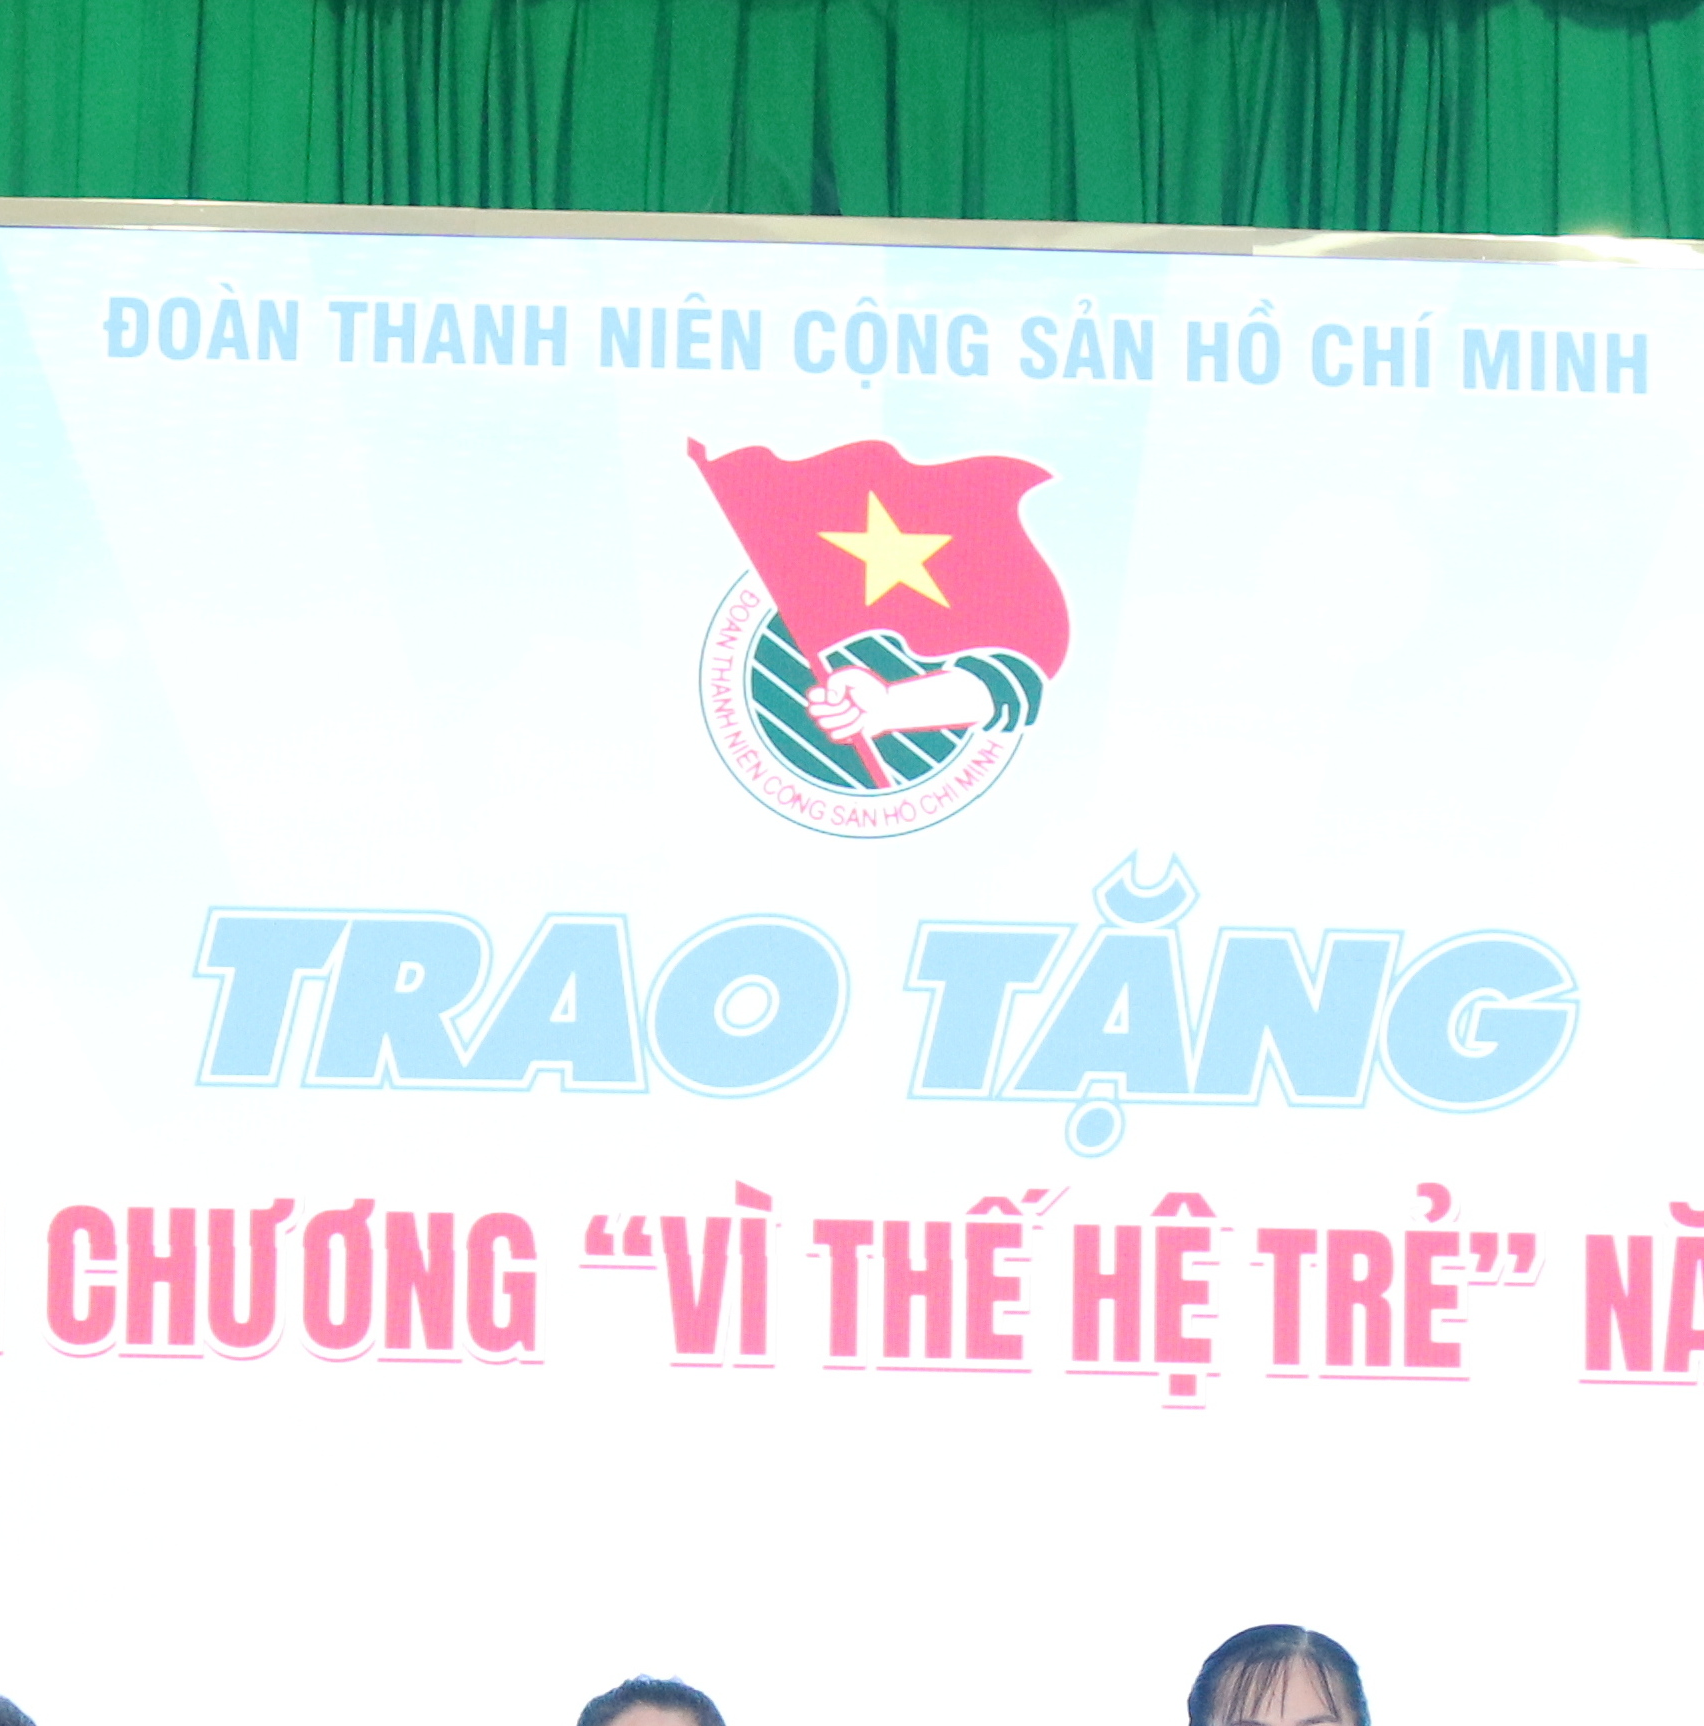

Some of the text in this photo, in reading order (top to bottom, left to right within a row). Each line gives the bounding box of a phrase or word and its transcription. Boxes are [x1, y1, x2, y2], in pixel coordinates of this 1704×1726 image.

[103, 282, 1648, 395] ĐOÀN THANH NIÊN CỘNG SẢN HỒ CHÍ MINH
[711, 655, 739, 729] THANH
[954, 739, 1004, 791] MINH
[192, 850, 1581, 1159] TRAO TẶNG
[46, 1198, 539, 1355] CHƯƠNG
[812, 1188, 1049, 1362] THẾ
[1071, 1192, 1217, 1397] HỆ
